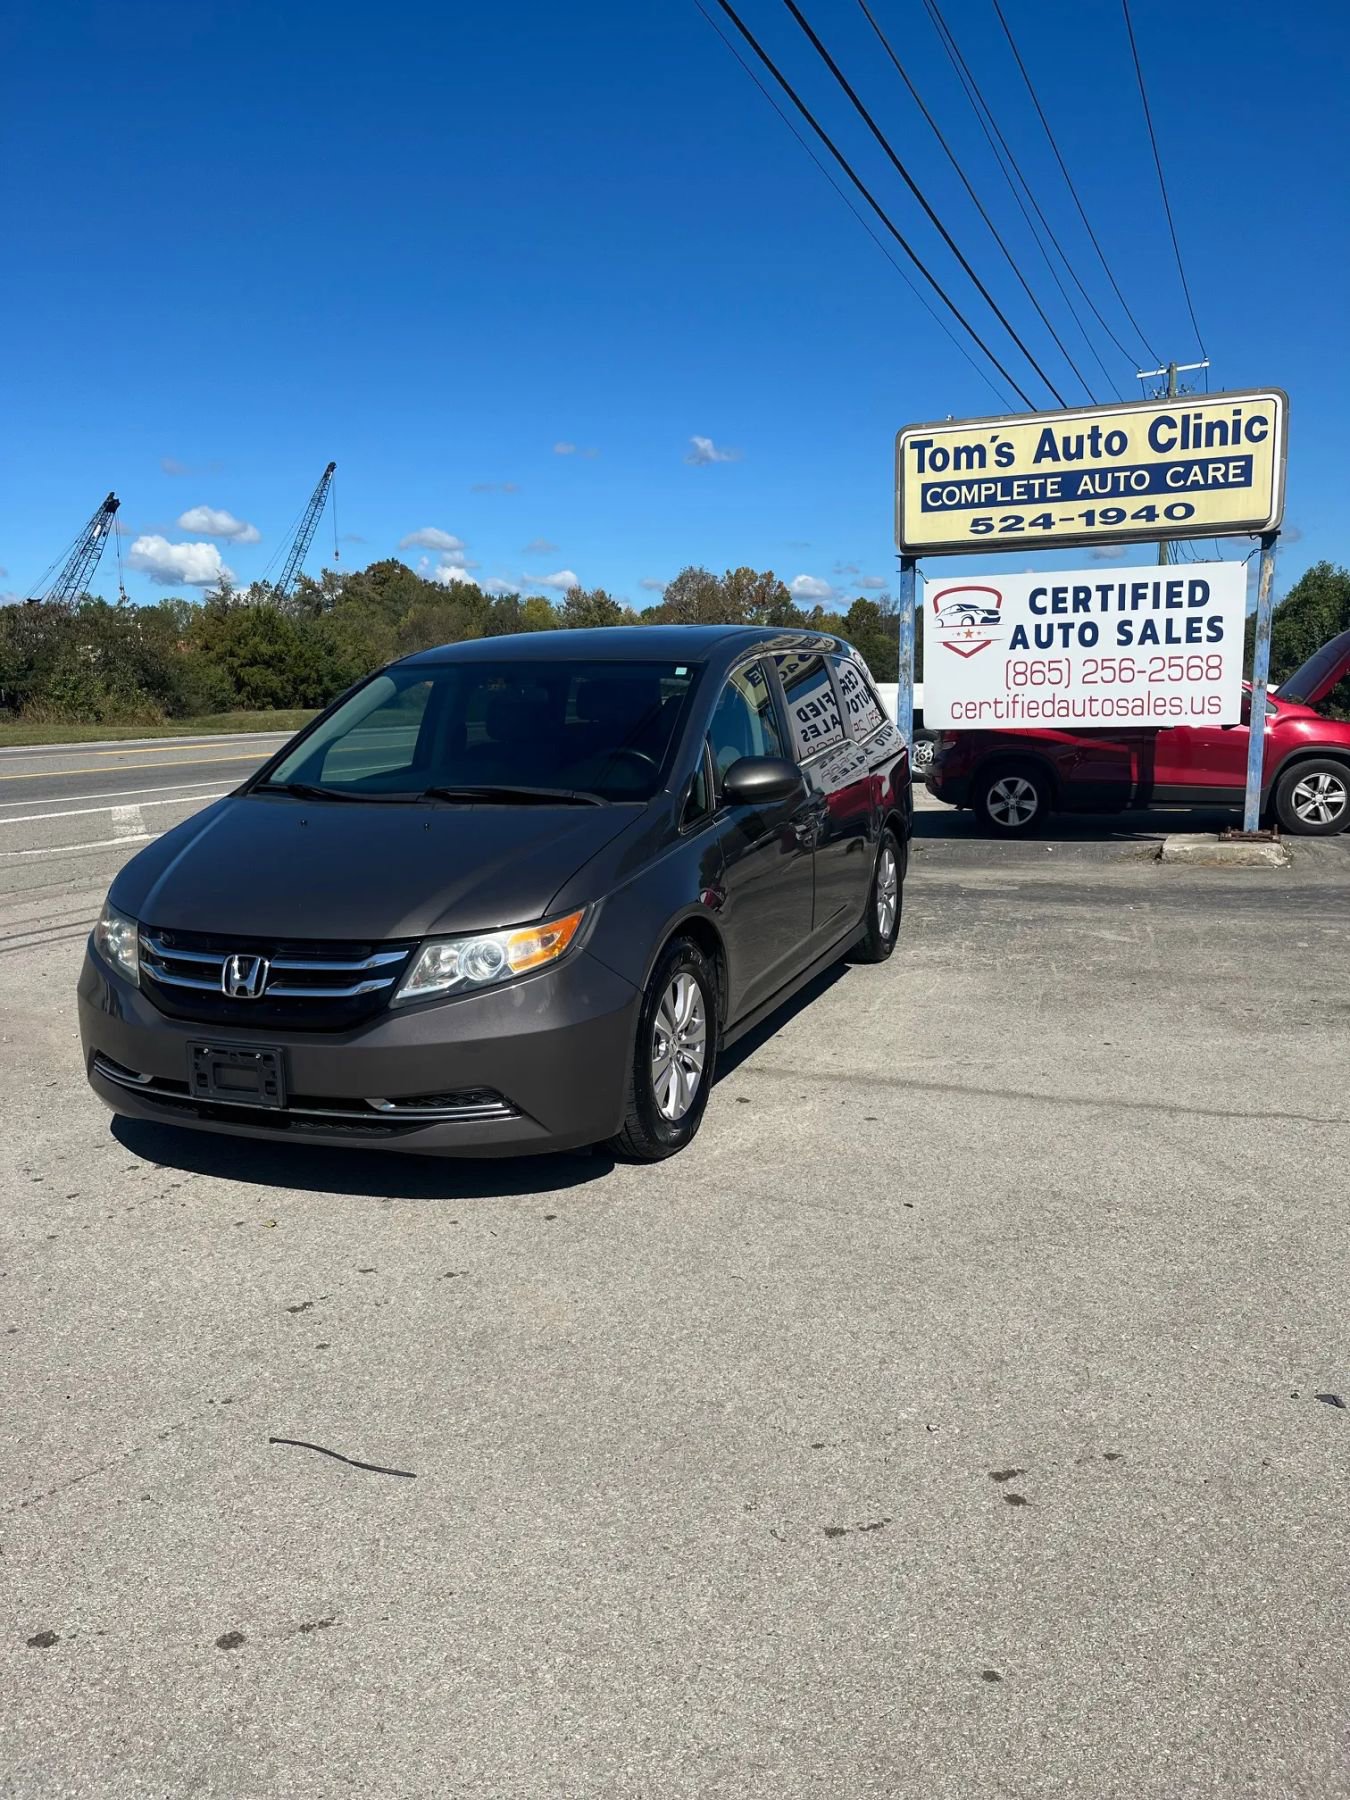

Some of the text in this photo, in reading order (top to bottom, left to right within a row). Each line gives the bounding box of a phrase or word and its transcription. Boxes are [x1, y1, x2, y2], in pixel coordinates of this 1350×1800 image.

[909, 408, 1269, 474] Tom's Auto Clinic
[926, 461, 1246, 507] COMPLETE AUTO CARE
[969, 502, 1196, 535] 524-1940
[1028, 579, 1211, 616] CERTIFIED
[1008, 615, 1224, 650] AUTO SALES
[1005, 654, 1223, 690] (865) 256-2568
[950, 690, 1222, 720] certifiedautosales.us
